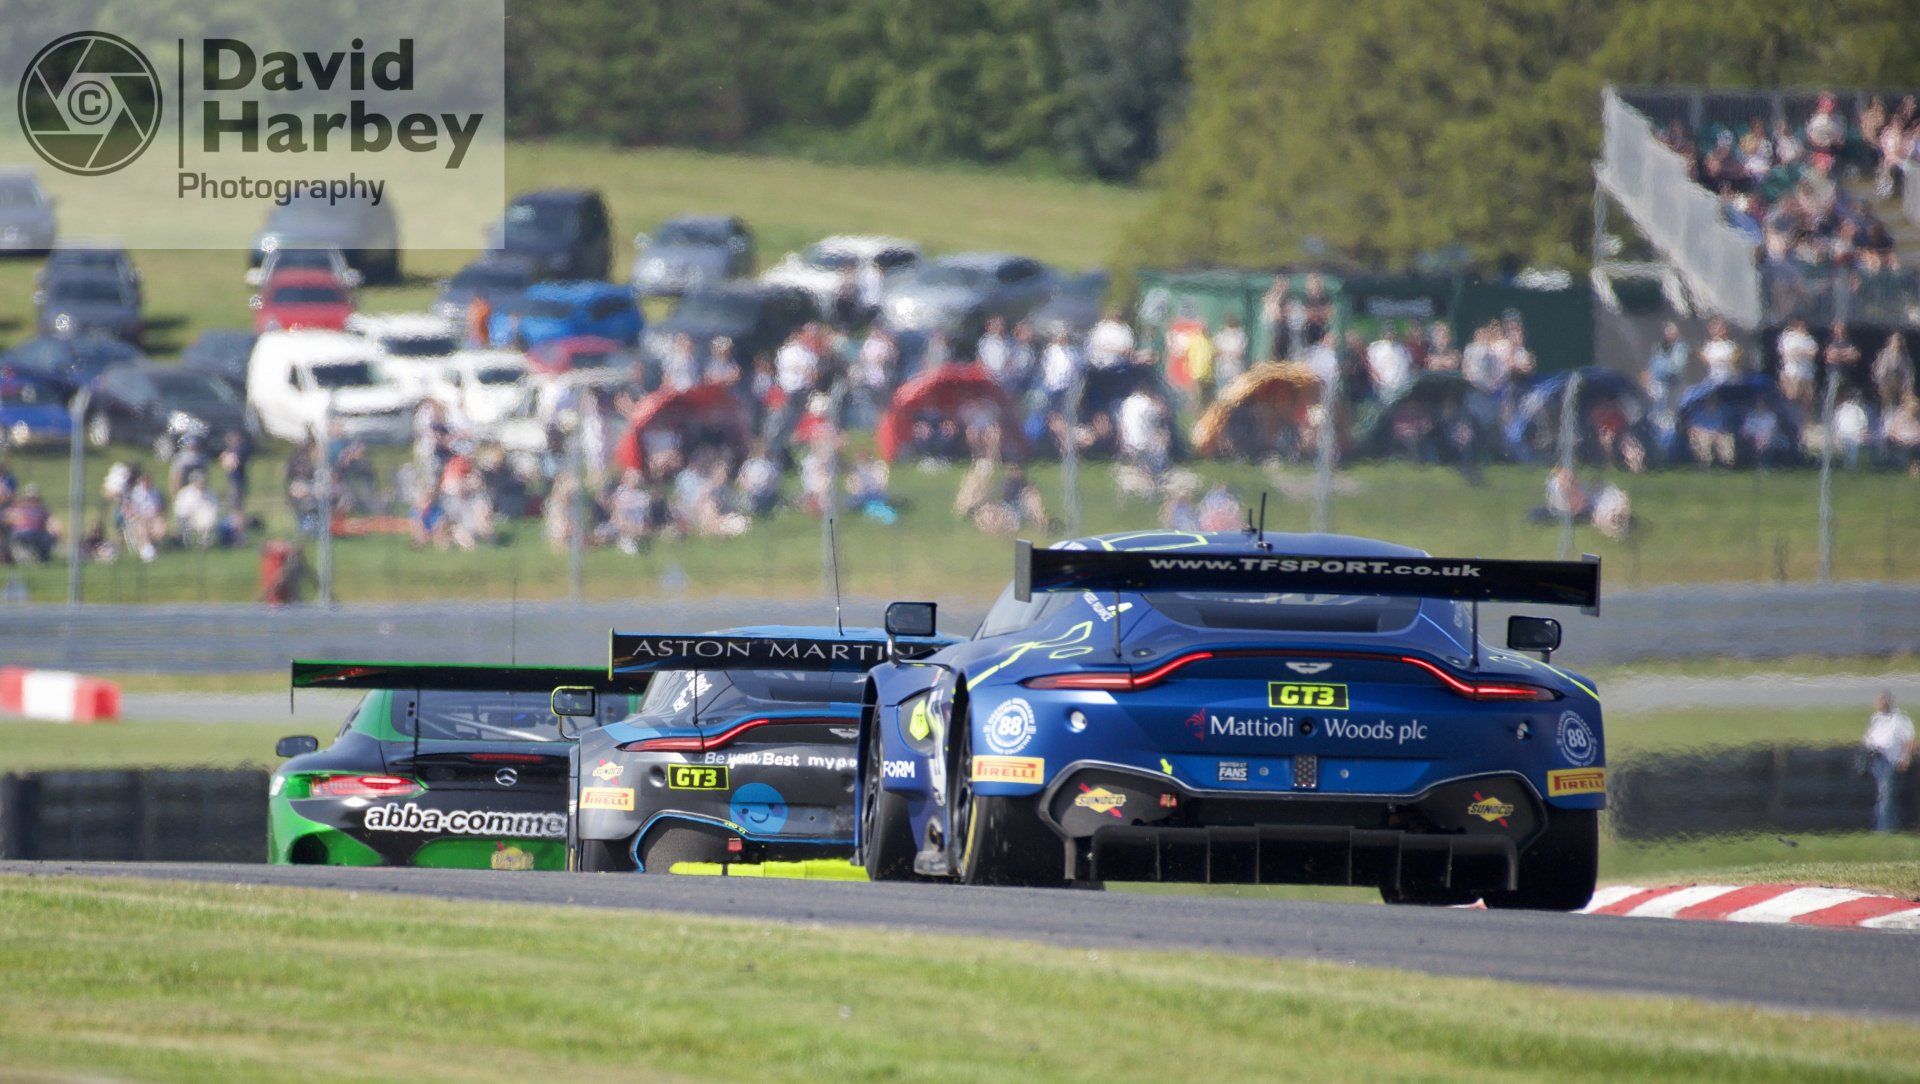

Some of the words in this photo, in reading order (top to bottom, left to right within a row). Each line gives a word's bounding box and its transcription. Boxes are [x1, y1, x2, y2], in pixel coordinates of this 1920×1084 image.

[1149, 556, 1481, 578] www.TFSPORT.co.uk
[632, 639, 750, 658] ASTON
[1280, 684, 1336, 706] GT3
[998, 715, 1023, 737] 88
[1210, 715, 1294, 737] Mattioli
[1323, 718, 1394, 740] Woods
[1398, 720, 1428, 744] plc
[1567, 728, 1587, 748] 88
[704, 752, 724, 764] Be
[762, 752, 800, 767] Best
[882, 760, 916, 778] FORM
[676, 768, 717, 787] GT3
[976, 760, 1037, 779] PIRELLI
[1219, 767, 1249, 778] FANS
[584, 791, 629, 806] PIRELLI
[1468, 802, 1515, 817] SUNOCO
